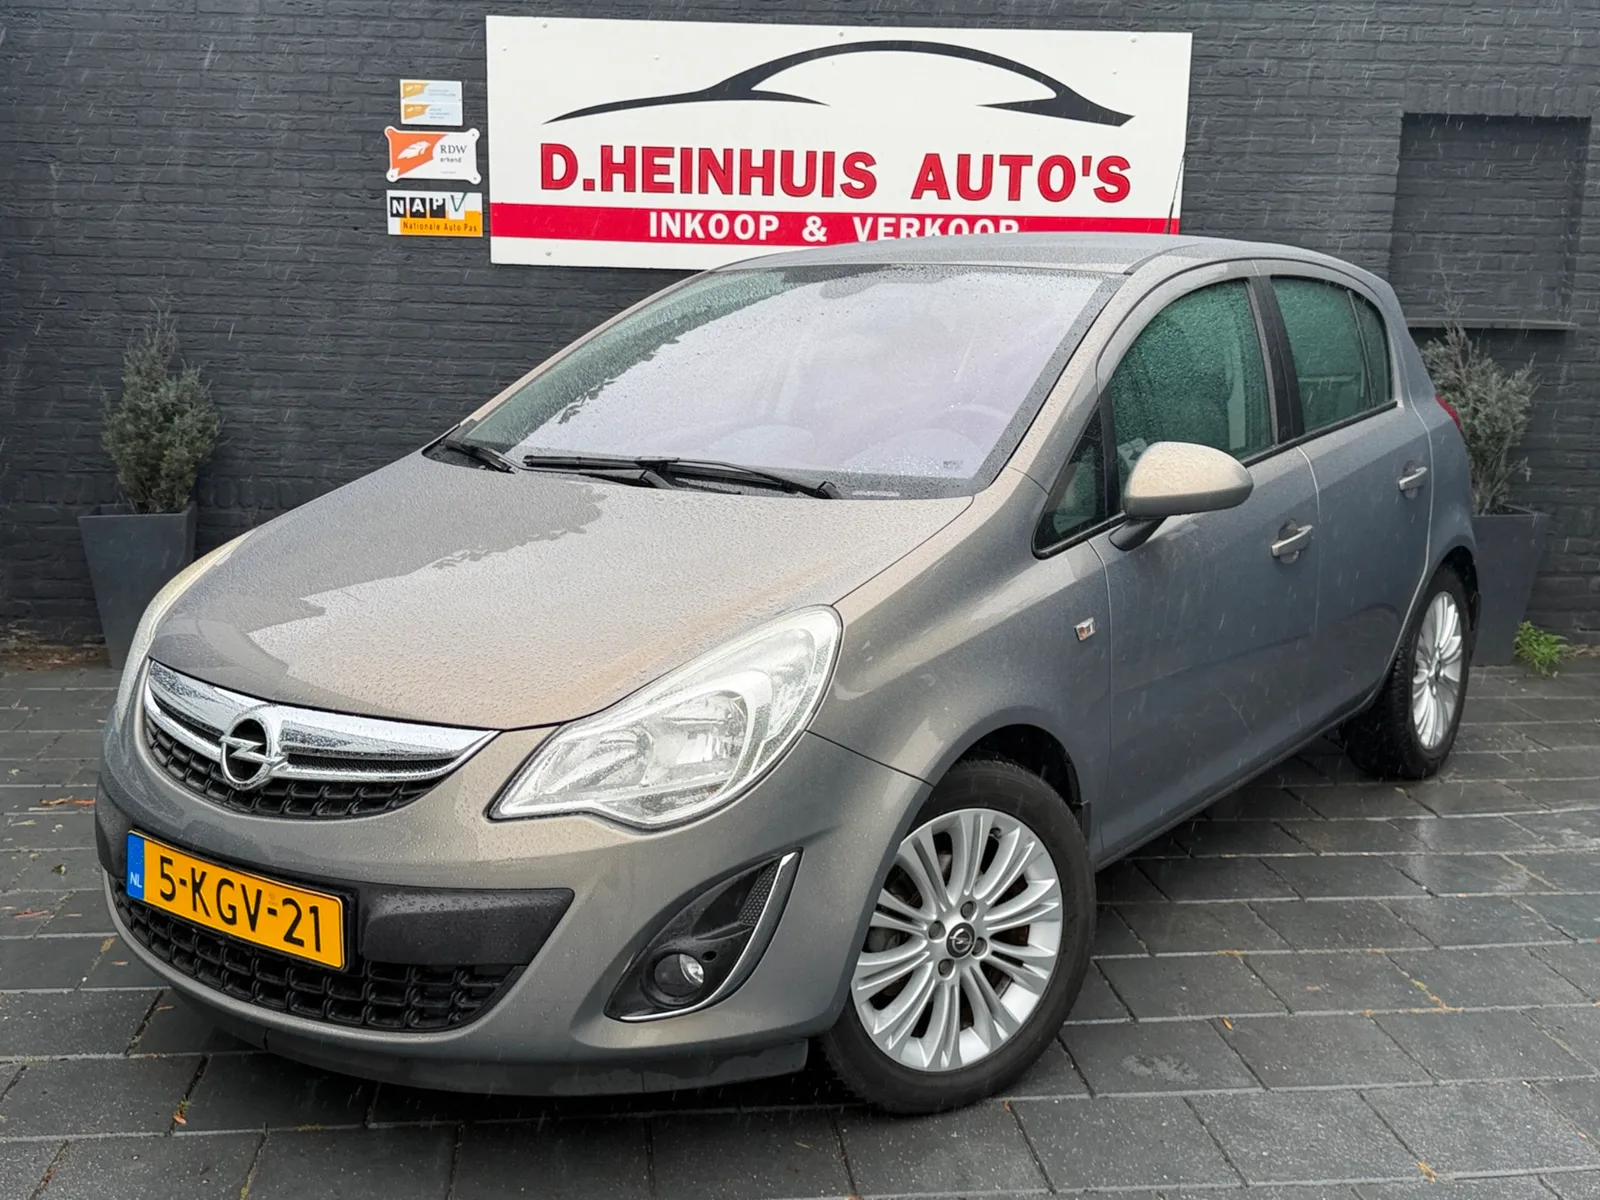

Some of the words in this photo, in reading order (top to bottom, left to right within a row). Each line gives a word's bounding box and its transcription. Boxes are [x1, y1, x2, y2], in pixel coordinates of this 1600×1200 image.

[440, 144, 467, 154] RDW
[540, 142, 877, 199] D.HEINHUIS
[910, 153, 1131, 203] AUTO'S
[403, 221, 440, 231] Nationale
[443, 223, 461, 232] Auto
[464, 223, 477, 232] Pas
[649, 211, 780, 241] INKOOP
[801, 215, 828, 242] &
[129, 871, 143, 889] NL
[158, 854, 322, 953] 5-KGV-21
